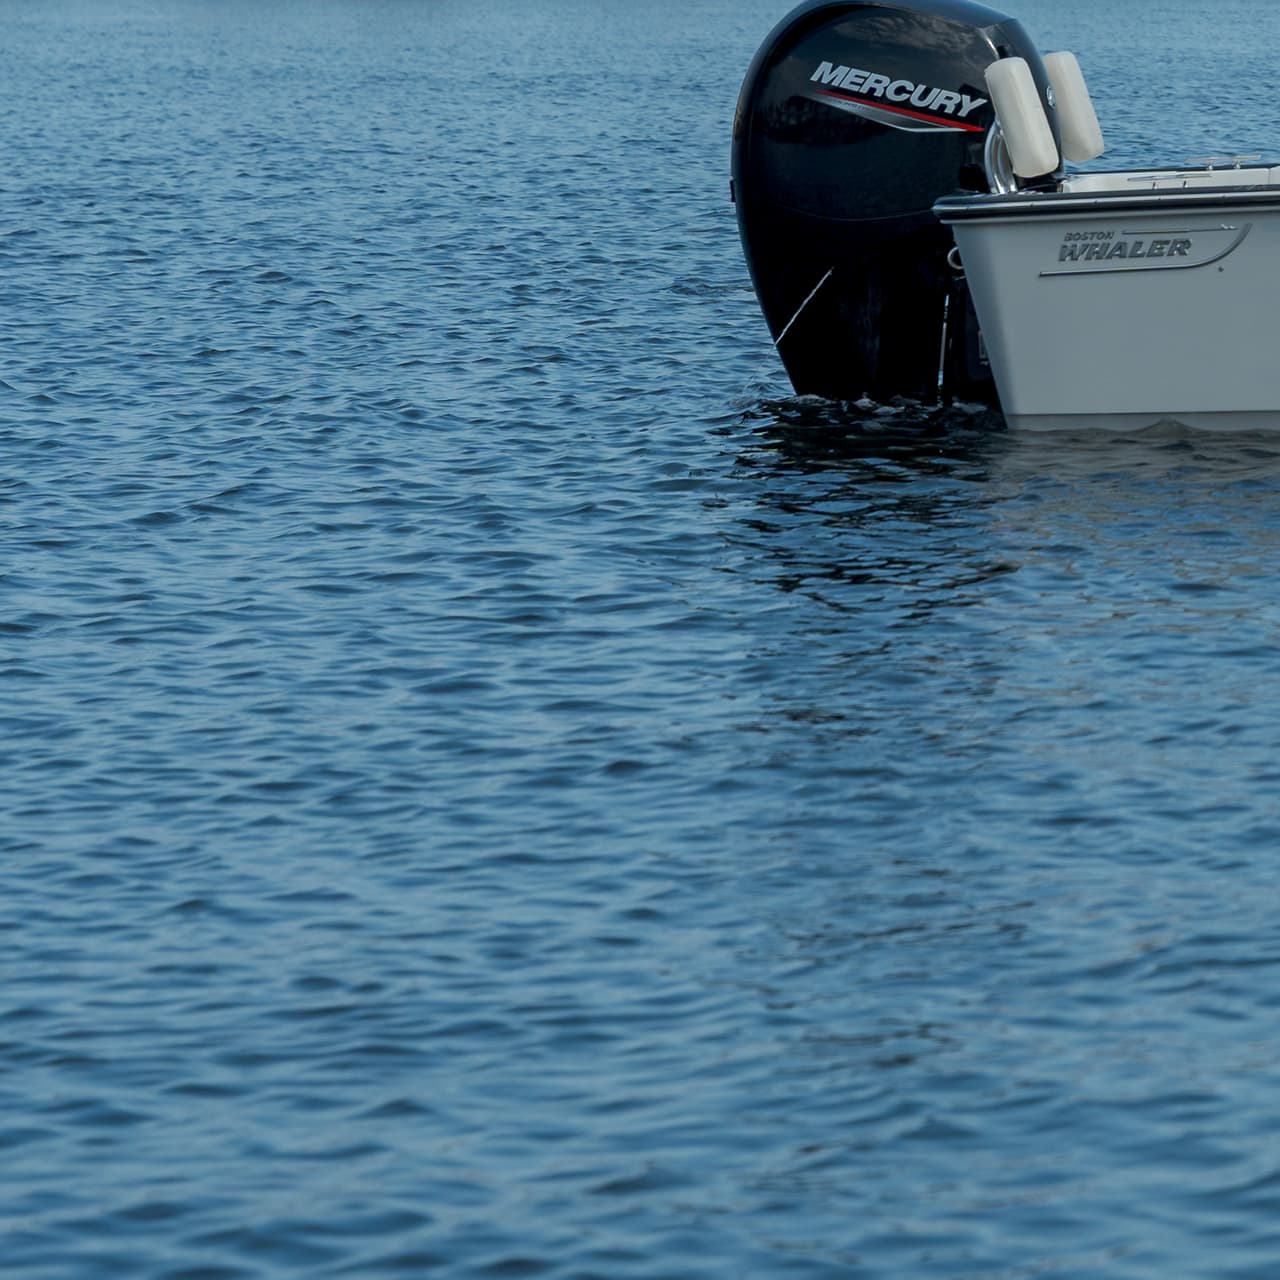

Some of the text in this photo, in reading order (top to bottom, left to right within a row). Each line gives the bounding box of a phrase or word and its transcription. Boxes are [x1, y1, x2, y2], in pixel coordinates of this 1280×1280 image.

[810, 61, 987, 117] MERCURY
[1064, 232, 1114, 242] BOSTON
[1058, 238, 1191, 262] WHALER
